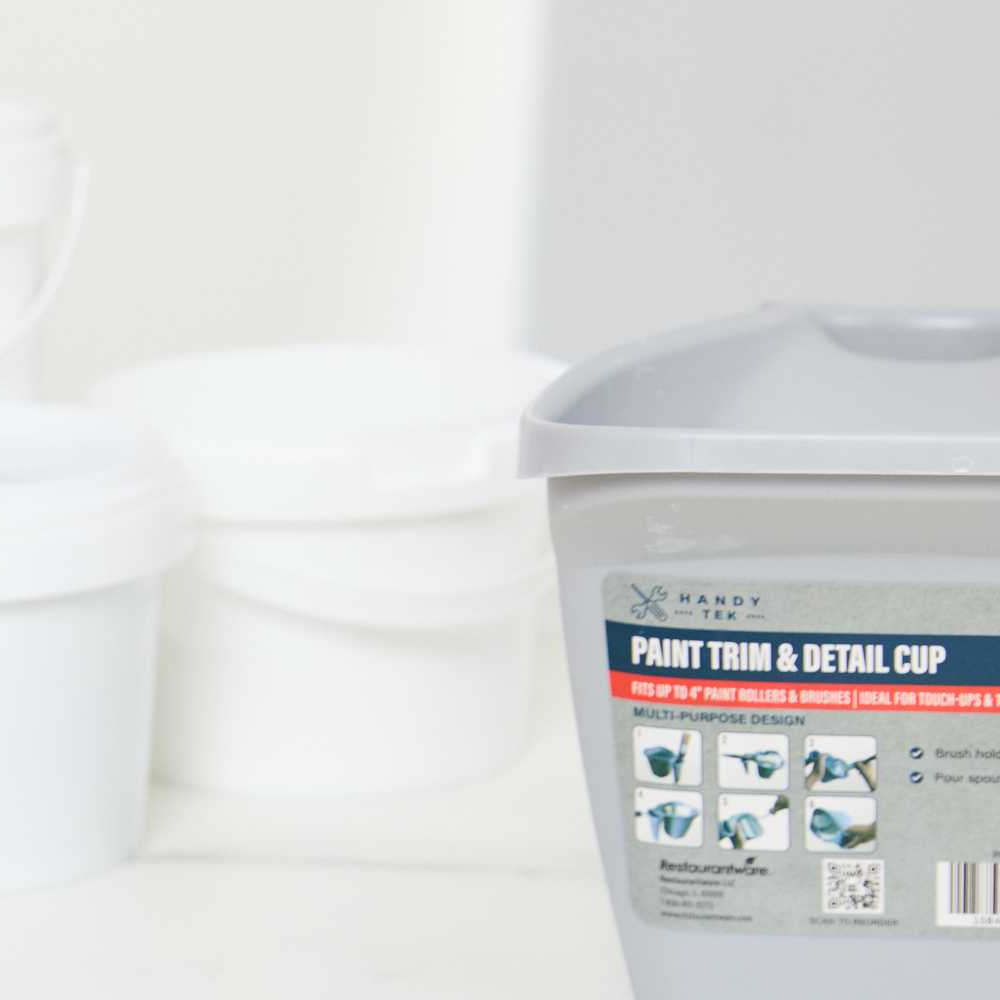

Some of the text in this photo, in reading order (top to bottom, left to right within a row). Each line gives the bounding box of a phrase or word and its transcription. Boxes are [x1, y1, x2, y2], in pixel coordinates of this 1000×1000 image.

[679, 593, 761, 607] HANDY
[702, 609, 737, 621] TEK
[631, 635, 946, 674] PAINT TRIM & DETAIL CUP
[631, 681, 655, 697] FITS
[656, 683, 672, 698] UP
[673, 685, 688, 700] TO
[689, 686, 703, 700] 4"
[705, 686, 736, 702] PAINT
[738, 688, 786, 703] ROLLERS
[788, 689, 799, 704] &
[801, 690, 851, 704] BRUSHES
[859, 691, 892, 705] IDEAL
[893, 691, 917, 706] FOR
[918, 692, 982, 707] TOUCH-UPS
[983, 693, 994, 707] &
[633, 707, 806, 726] MULTI-PURPOSE DESIGN
[936, 747, 972, 759] Brush
[936, 772, 964, 783] Pour
[660, 858, 769, 876] Restaurantware
